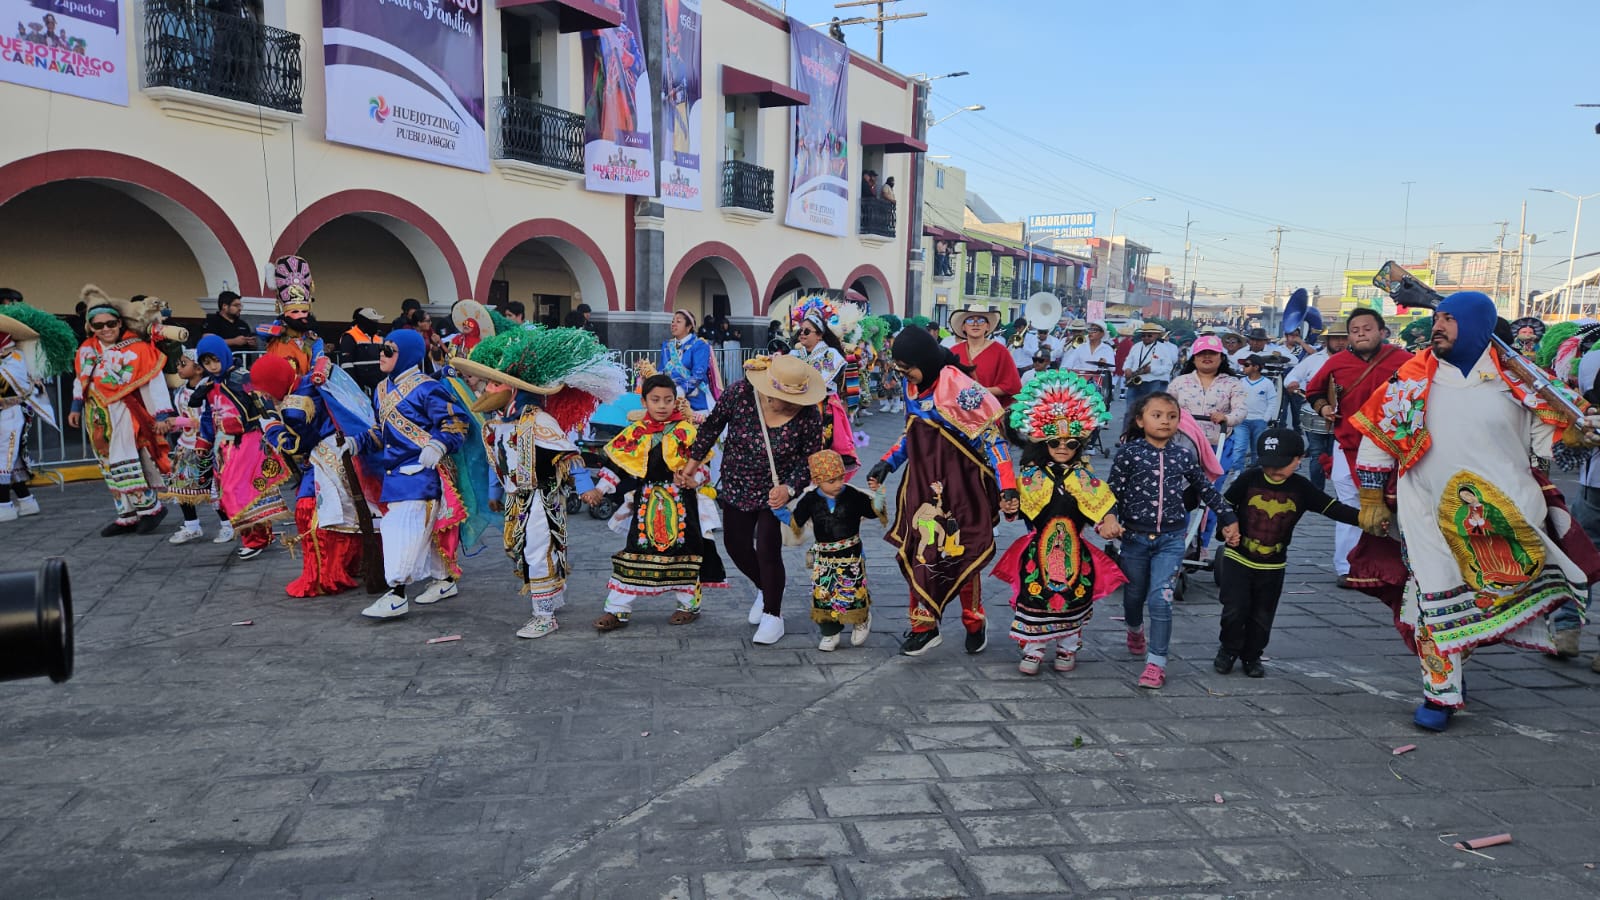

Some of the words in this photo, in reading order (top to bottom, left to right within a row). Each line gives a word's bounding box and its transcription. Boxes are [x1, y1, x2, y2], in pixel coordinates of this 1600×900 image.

[2, 48, 84, 77] CARNAVAL
[393, 105, 460, 134] HUEJOTZINGO
[396, 127, 426, 143] PUEBLO
[592, 163, 650, 178] HUEJOTZINGO
[1030, 214, 1093, 227] LABORATORIO
